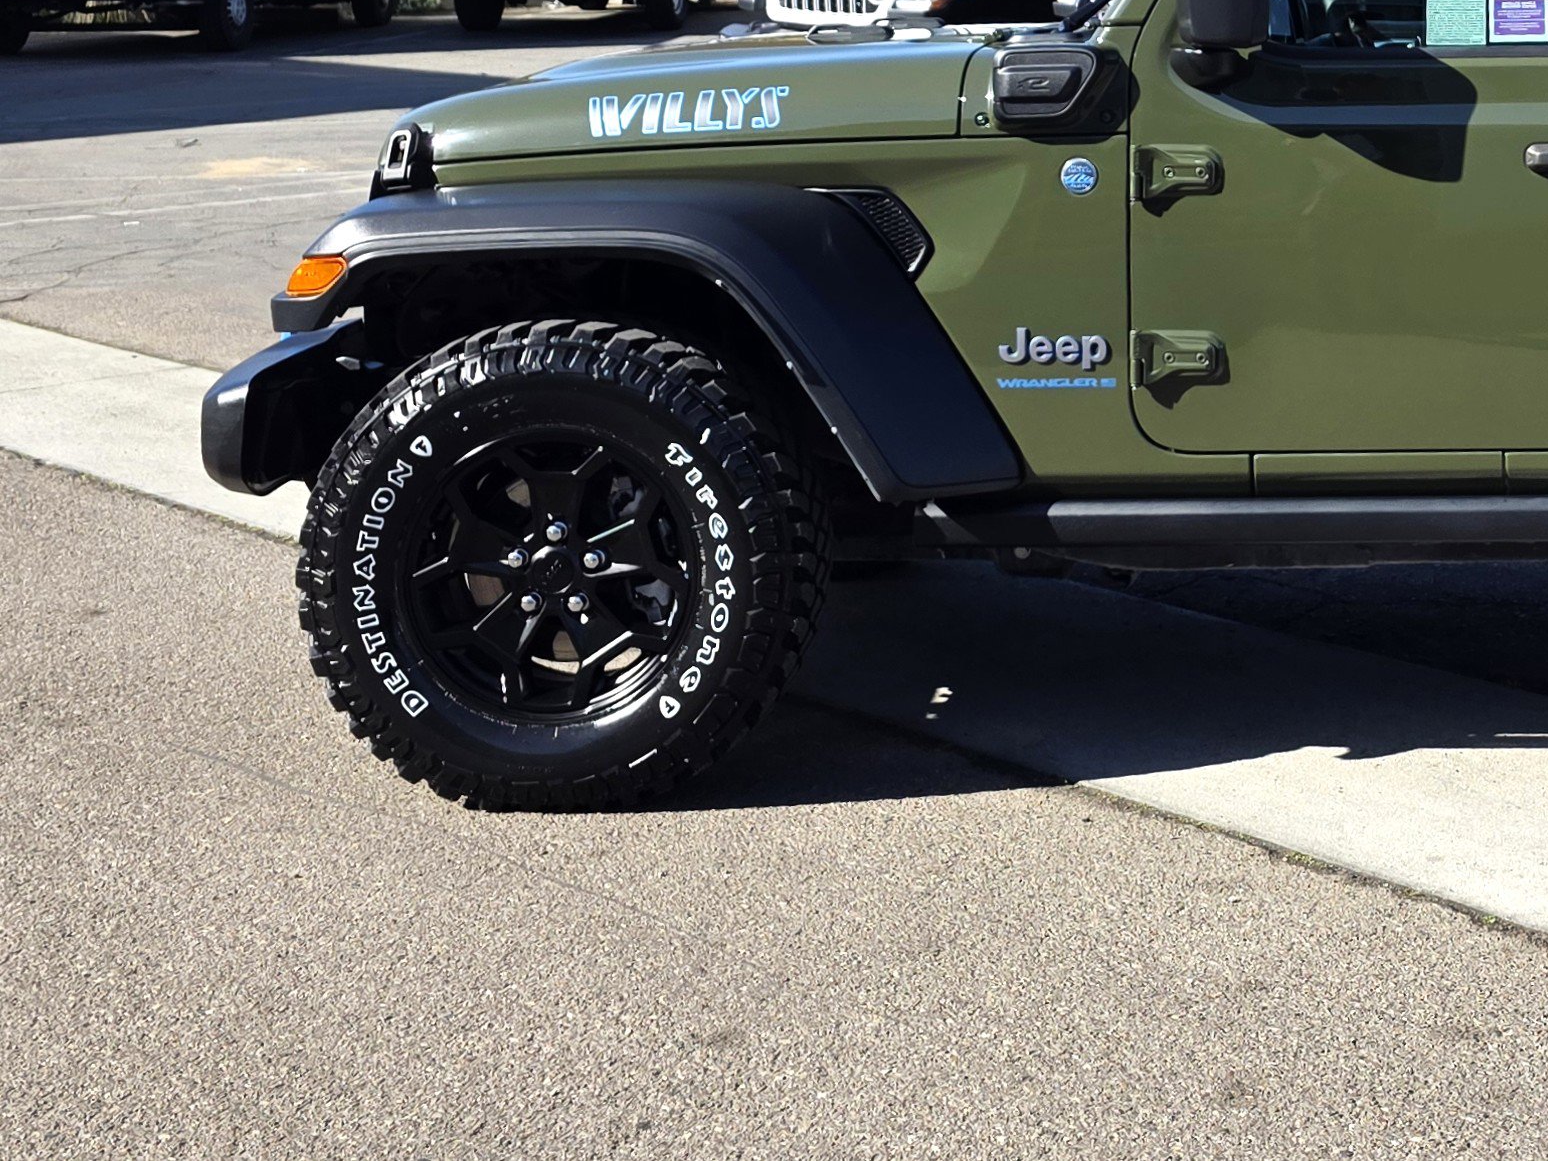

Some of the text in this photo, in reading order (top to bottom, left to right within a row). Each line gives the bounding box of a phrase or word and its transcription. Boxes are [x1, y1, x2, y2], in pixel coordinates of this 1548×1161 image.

[589, 86, 789, 137] WILLYS
[998, 327, 1108, 370] Jeep
[997, 378, 1098, 389] WRANGLER
[352, 458, 429, 718] DESTINATION
